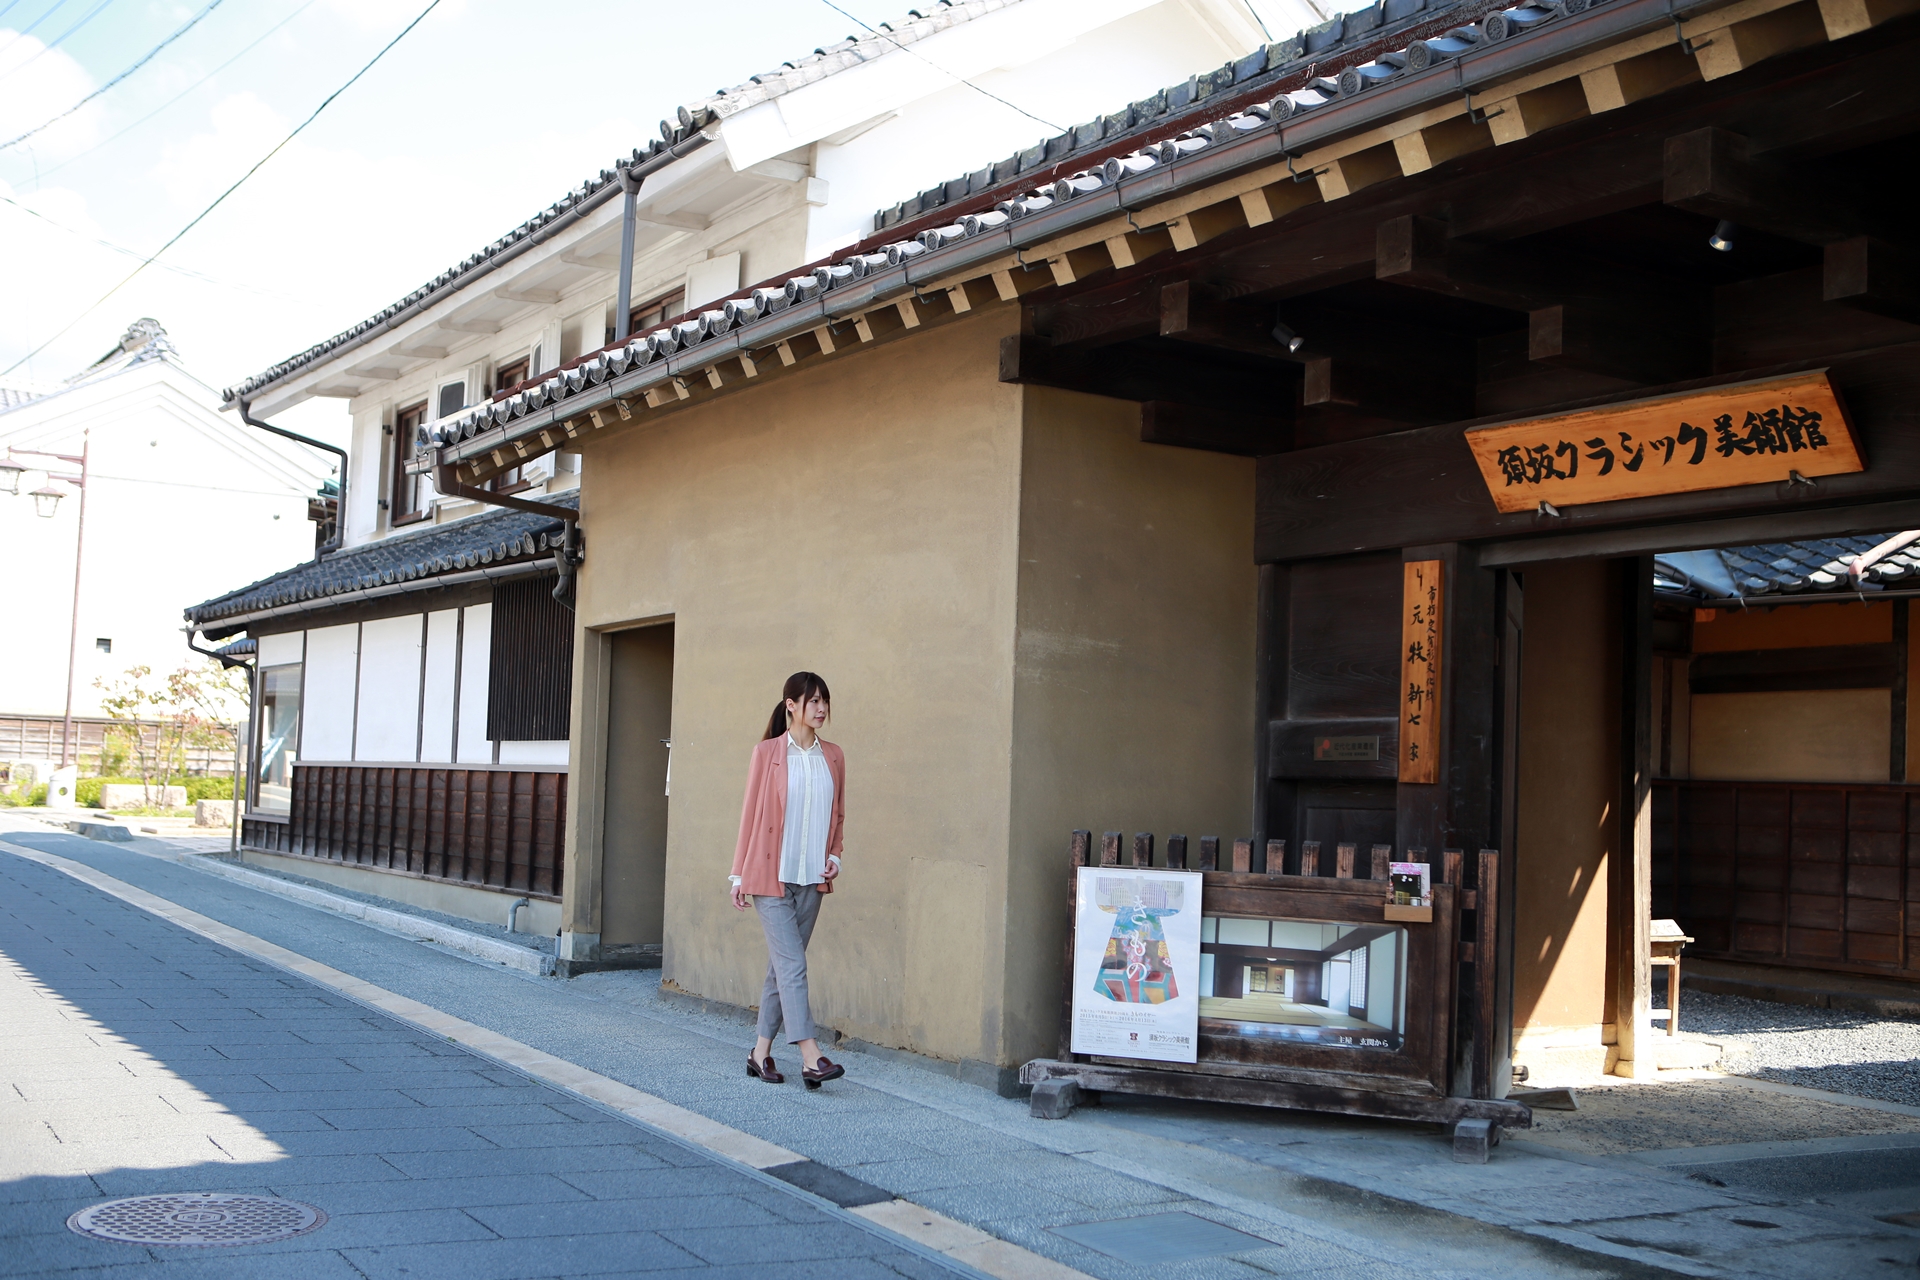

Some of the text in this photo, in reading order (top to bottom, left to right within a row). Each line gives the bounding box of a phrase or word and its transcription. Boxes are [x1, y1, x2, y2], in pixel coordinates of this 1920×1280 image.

[1498, 404, 1829, 487] 須坂クラシック美術館
[1126, 895, 1148, 982] きもの
[1149, 1034, 1190, 1044] 須坂クラシック美術館
[1360, 1037, 1388, 1047] 玄関から
